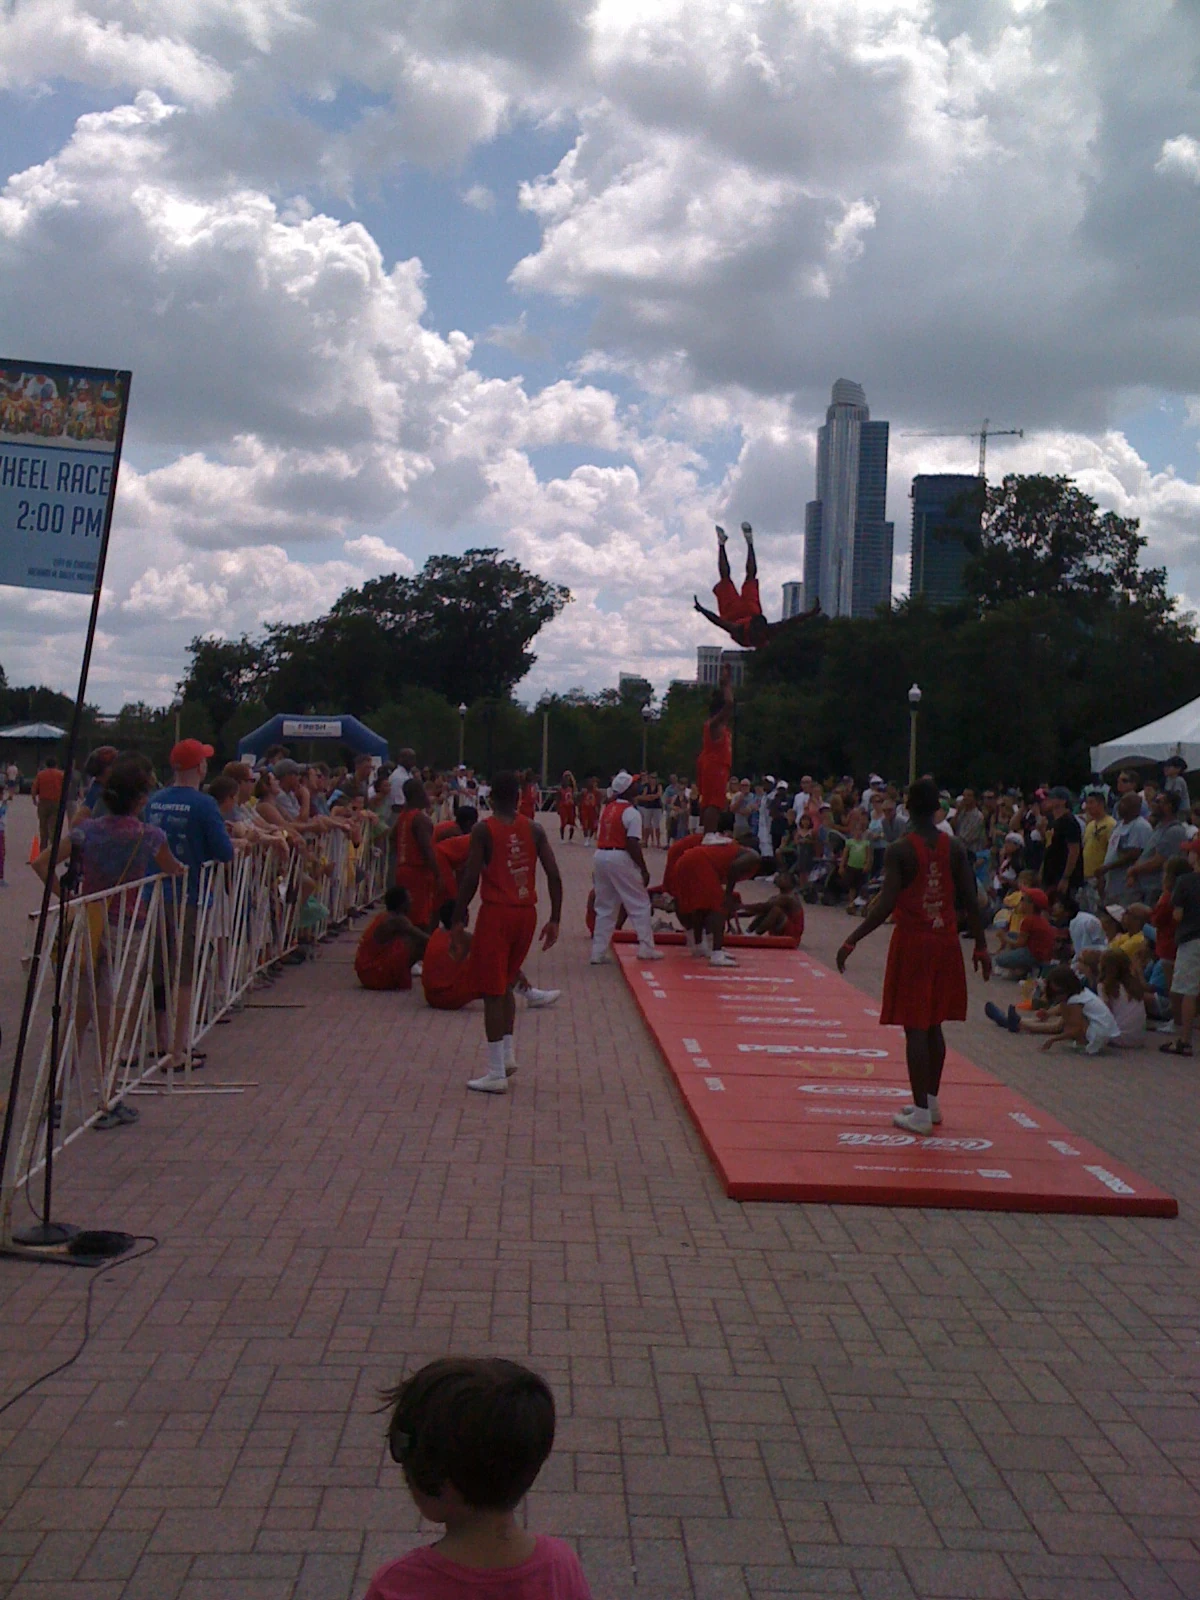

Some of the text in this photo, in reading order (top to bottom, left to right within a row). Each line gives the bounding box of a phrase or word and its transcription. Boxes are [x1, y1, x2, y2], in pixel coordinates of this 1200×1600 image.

[0, 456, 111, 496] HEEL RACE
[17, 500, 103, 538] 2:00 PM
